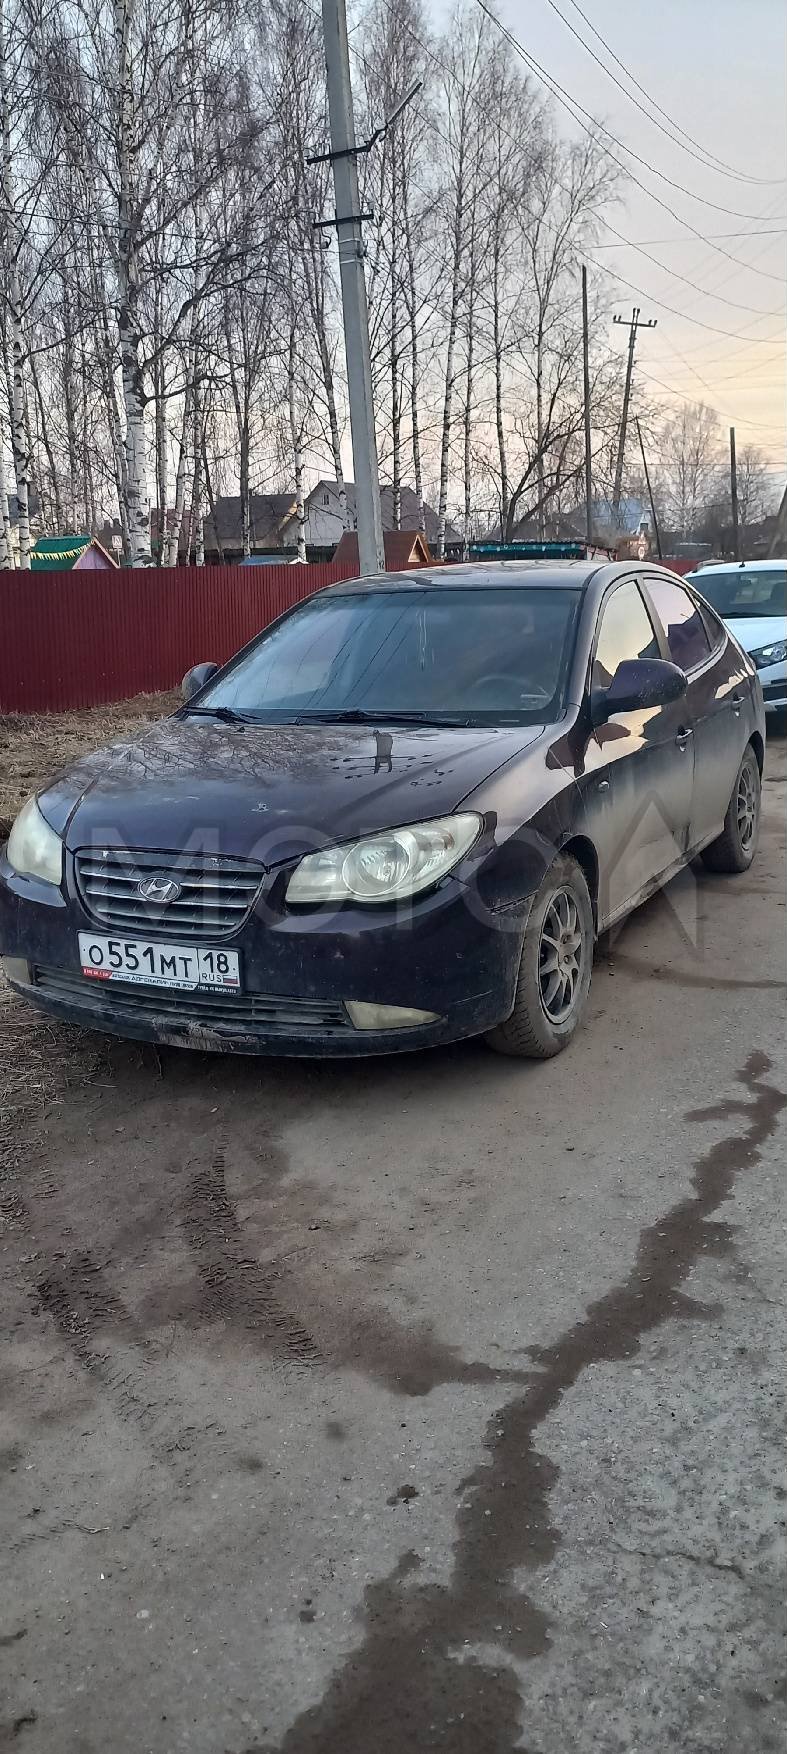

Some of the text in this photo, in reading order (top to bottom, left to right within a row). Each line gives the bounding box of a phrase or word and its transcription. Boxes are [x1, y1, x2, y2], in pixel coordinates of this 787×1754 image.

[88, 940, 230, 979] О551МТ 18
[201, 972, 222, 984] RUS
